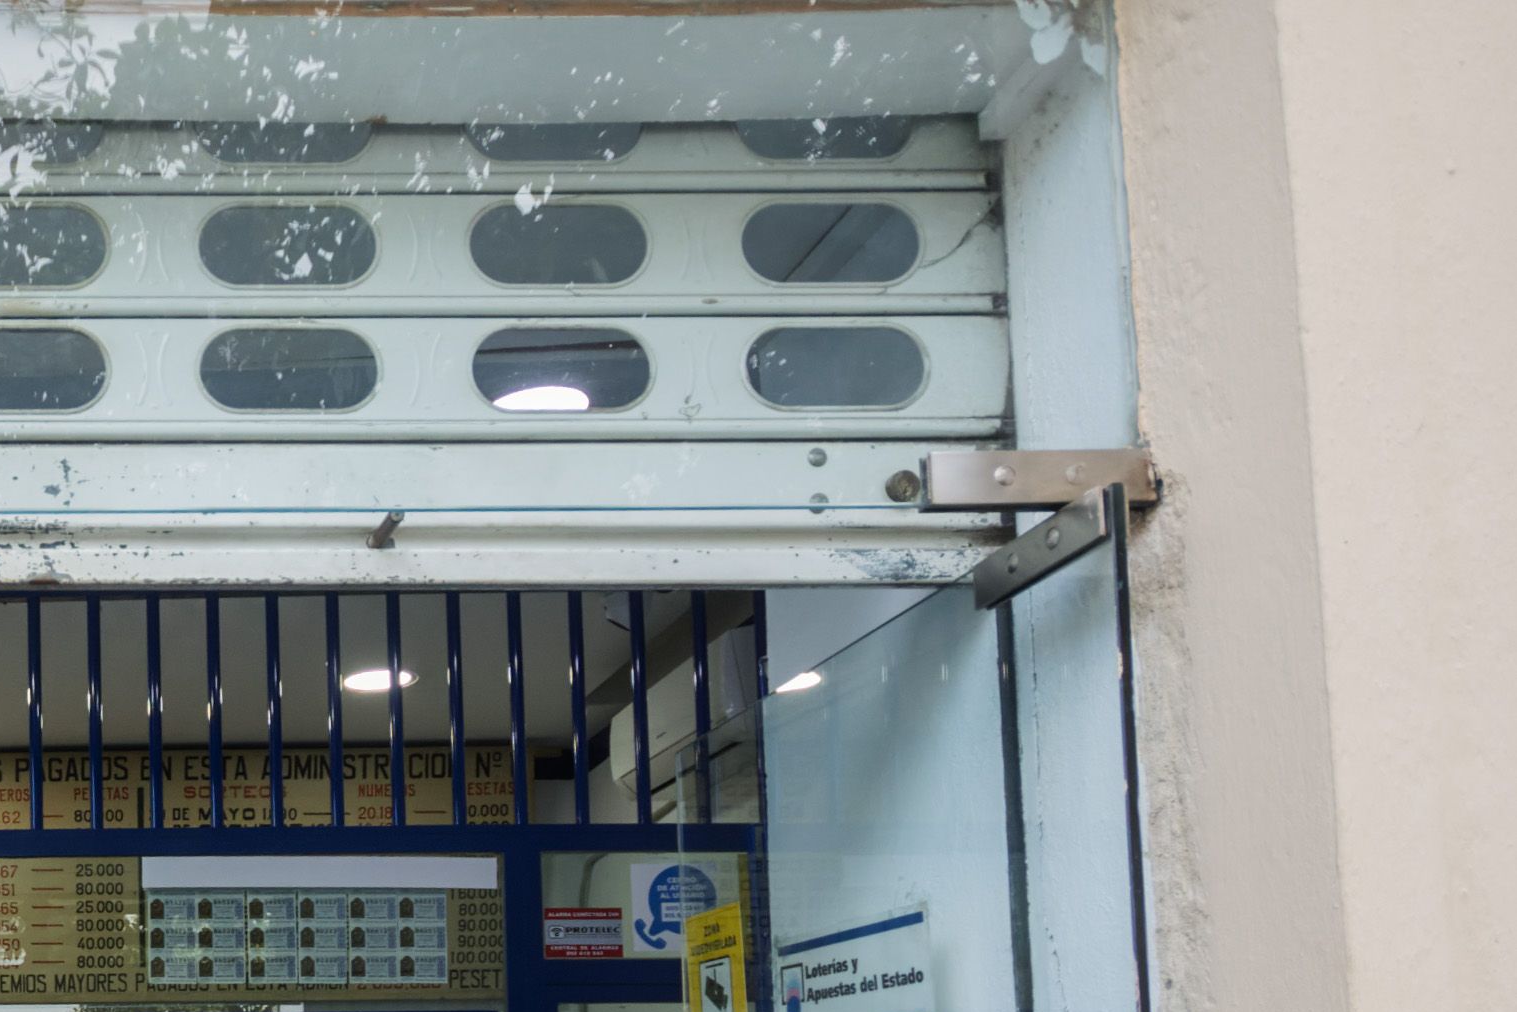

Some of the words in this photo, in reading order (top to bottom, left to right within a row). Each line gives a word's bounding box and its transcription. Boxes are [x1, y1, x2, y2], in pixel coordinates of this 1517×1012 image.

[172, 807, 190, 821] DE
[75, 863, 124, 877] 25.000
[75, 881, 124, 896] 80.000
[75, 900, 124, 914] 25.000
[565, 925, 620, 934] PROTELEC
[805, 959, 849, 980] Loterías
[851, 958, 859, 975] y
[54, 973, 128, 993] MAYORES
[806, 981, 857, 1005] Apuestas
[859, 974, 878, 993] del
[881, 966, 925, 990] Estado
